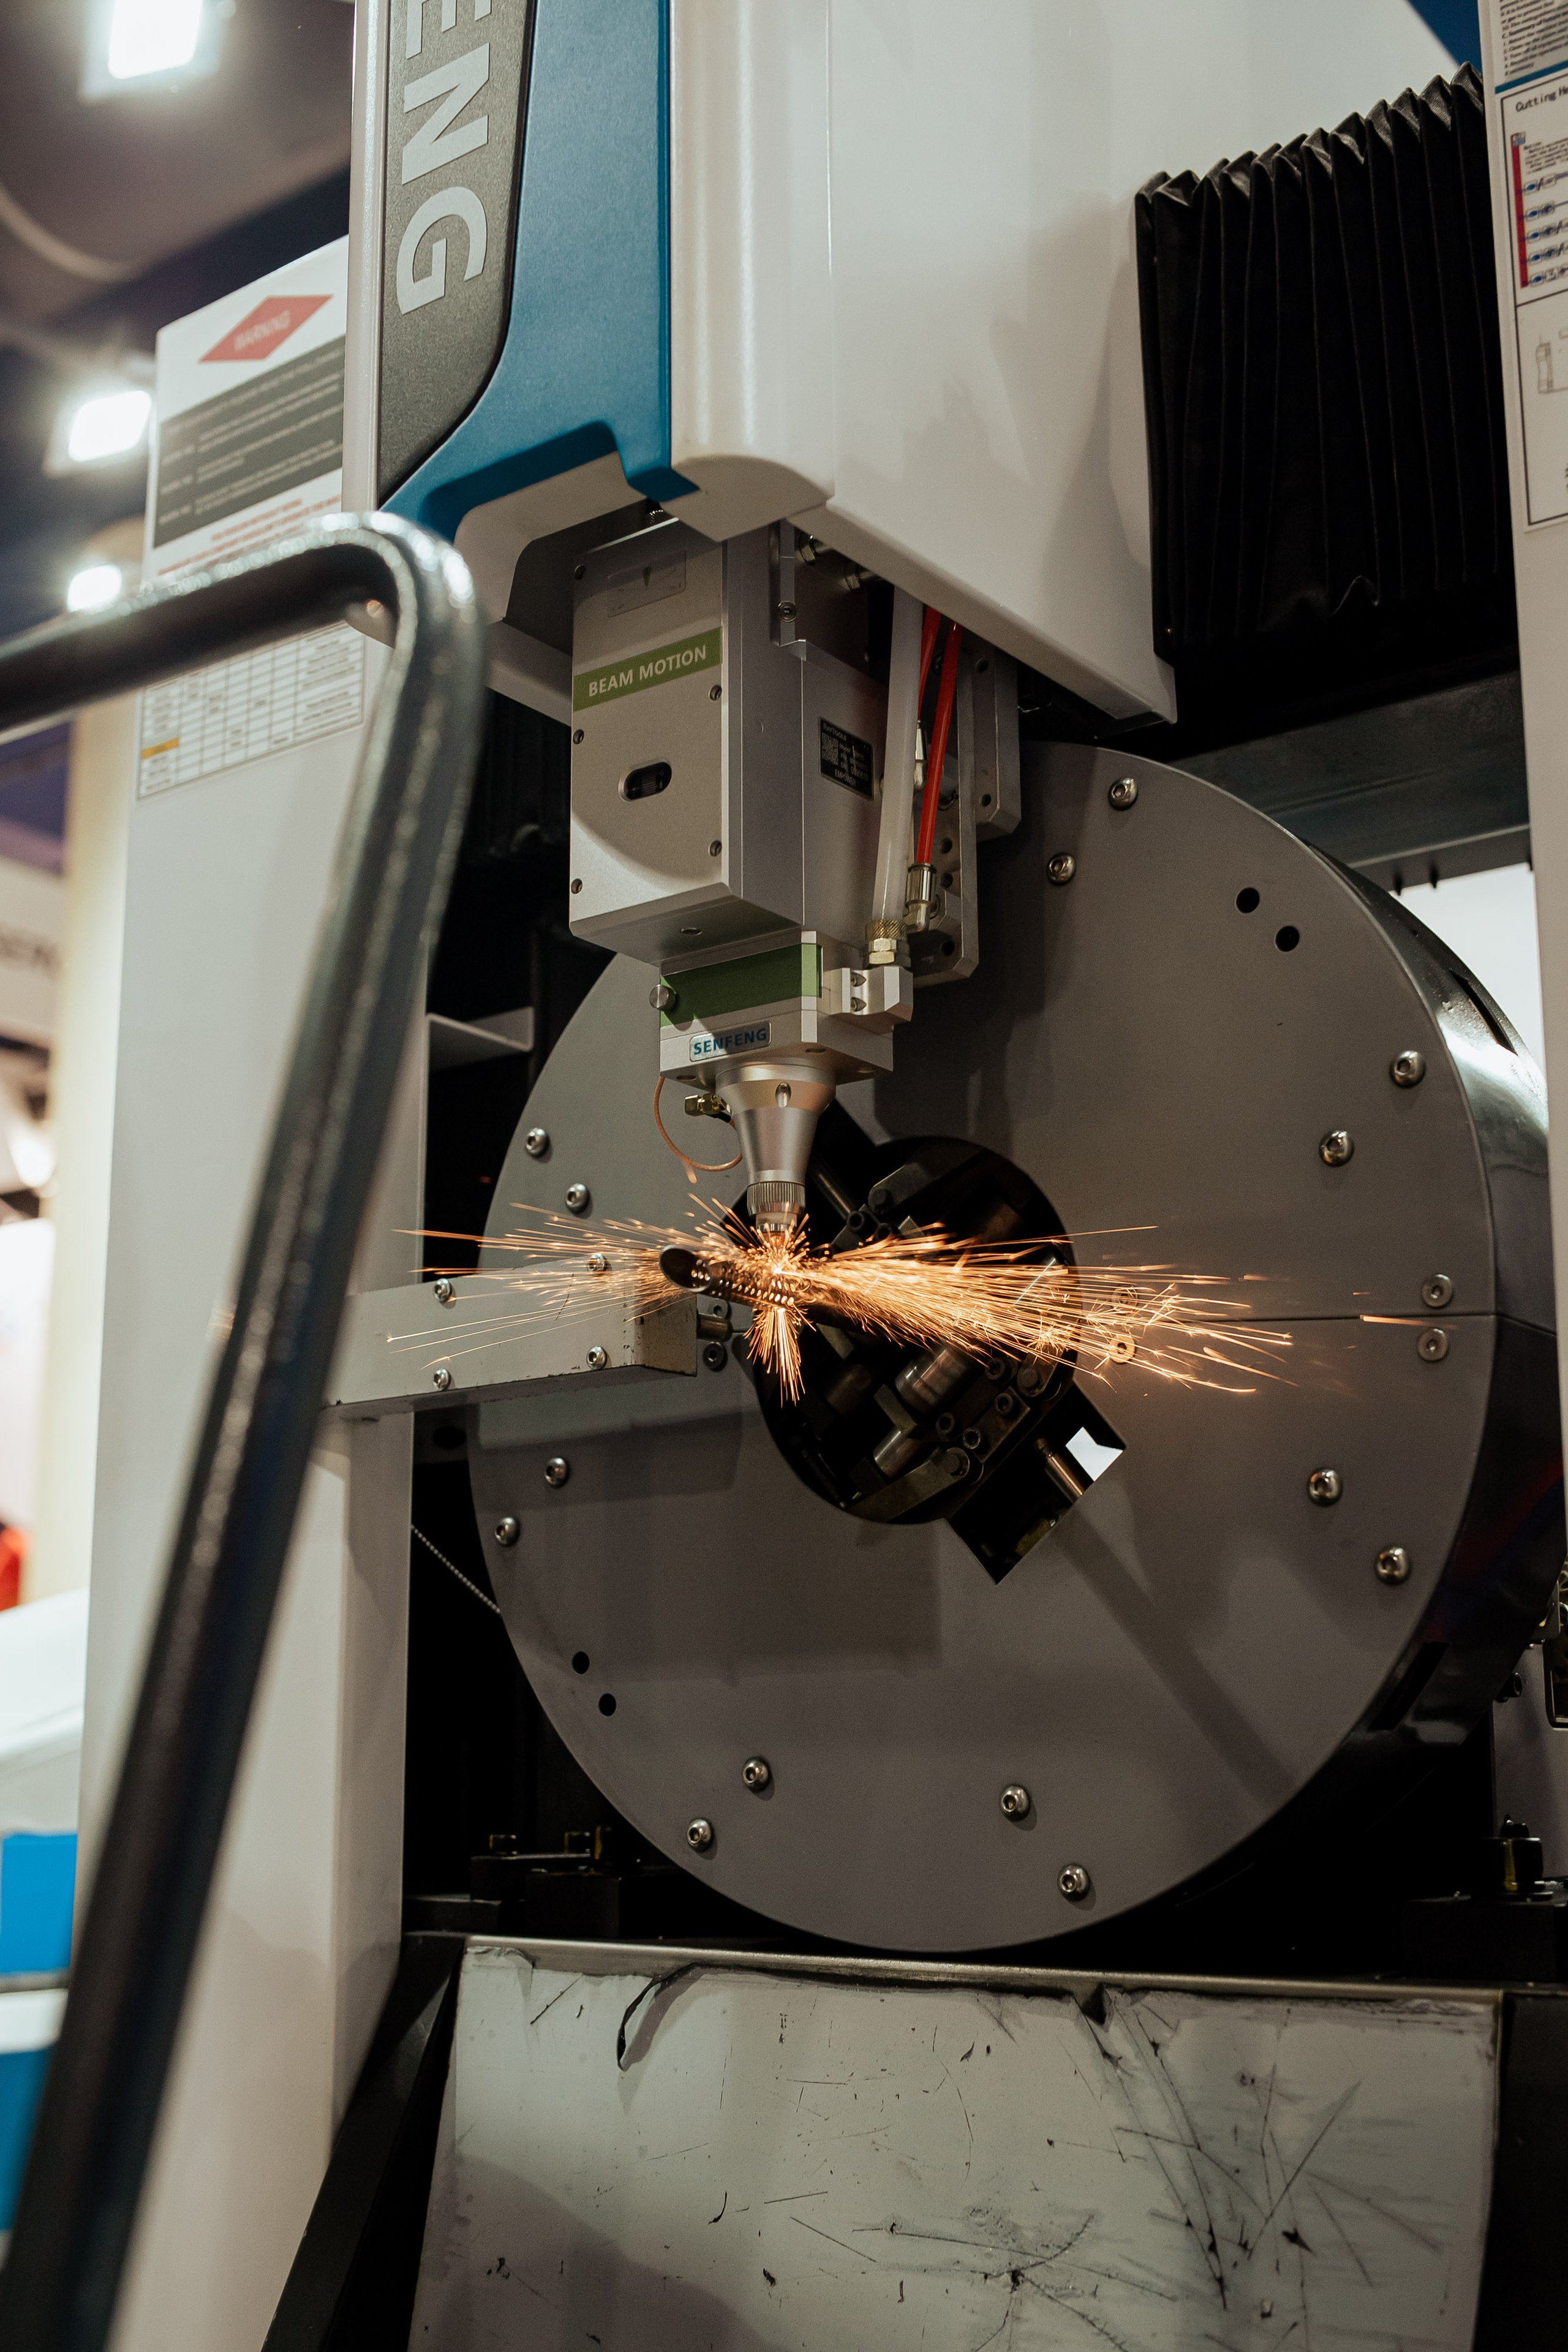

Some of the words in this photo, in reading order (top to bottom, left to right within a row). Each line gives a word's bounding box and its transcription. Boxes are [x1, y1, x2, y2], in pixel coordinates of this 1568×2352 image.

[1515, 92, 1556, 112] Cutting
[589, 669, 633, 697] BEAM
[639, 644, 706, 681] MOTION
[693, 1028, 766, 1055] SENFENG
